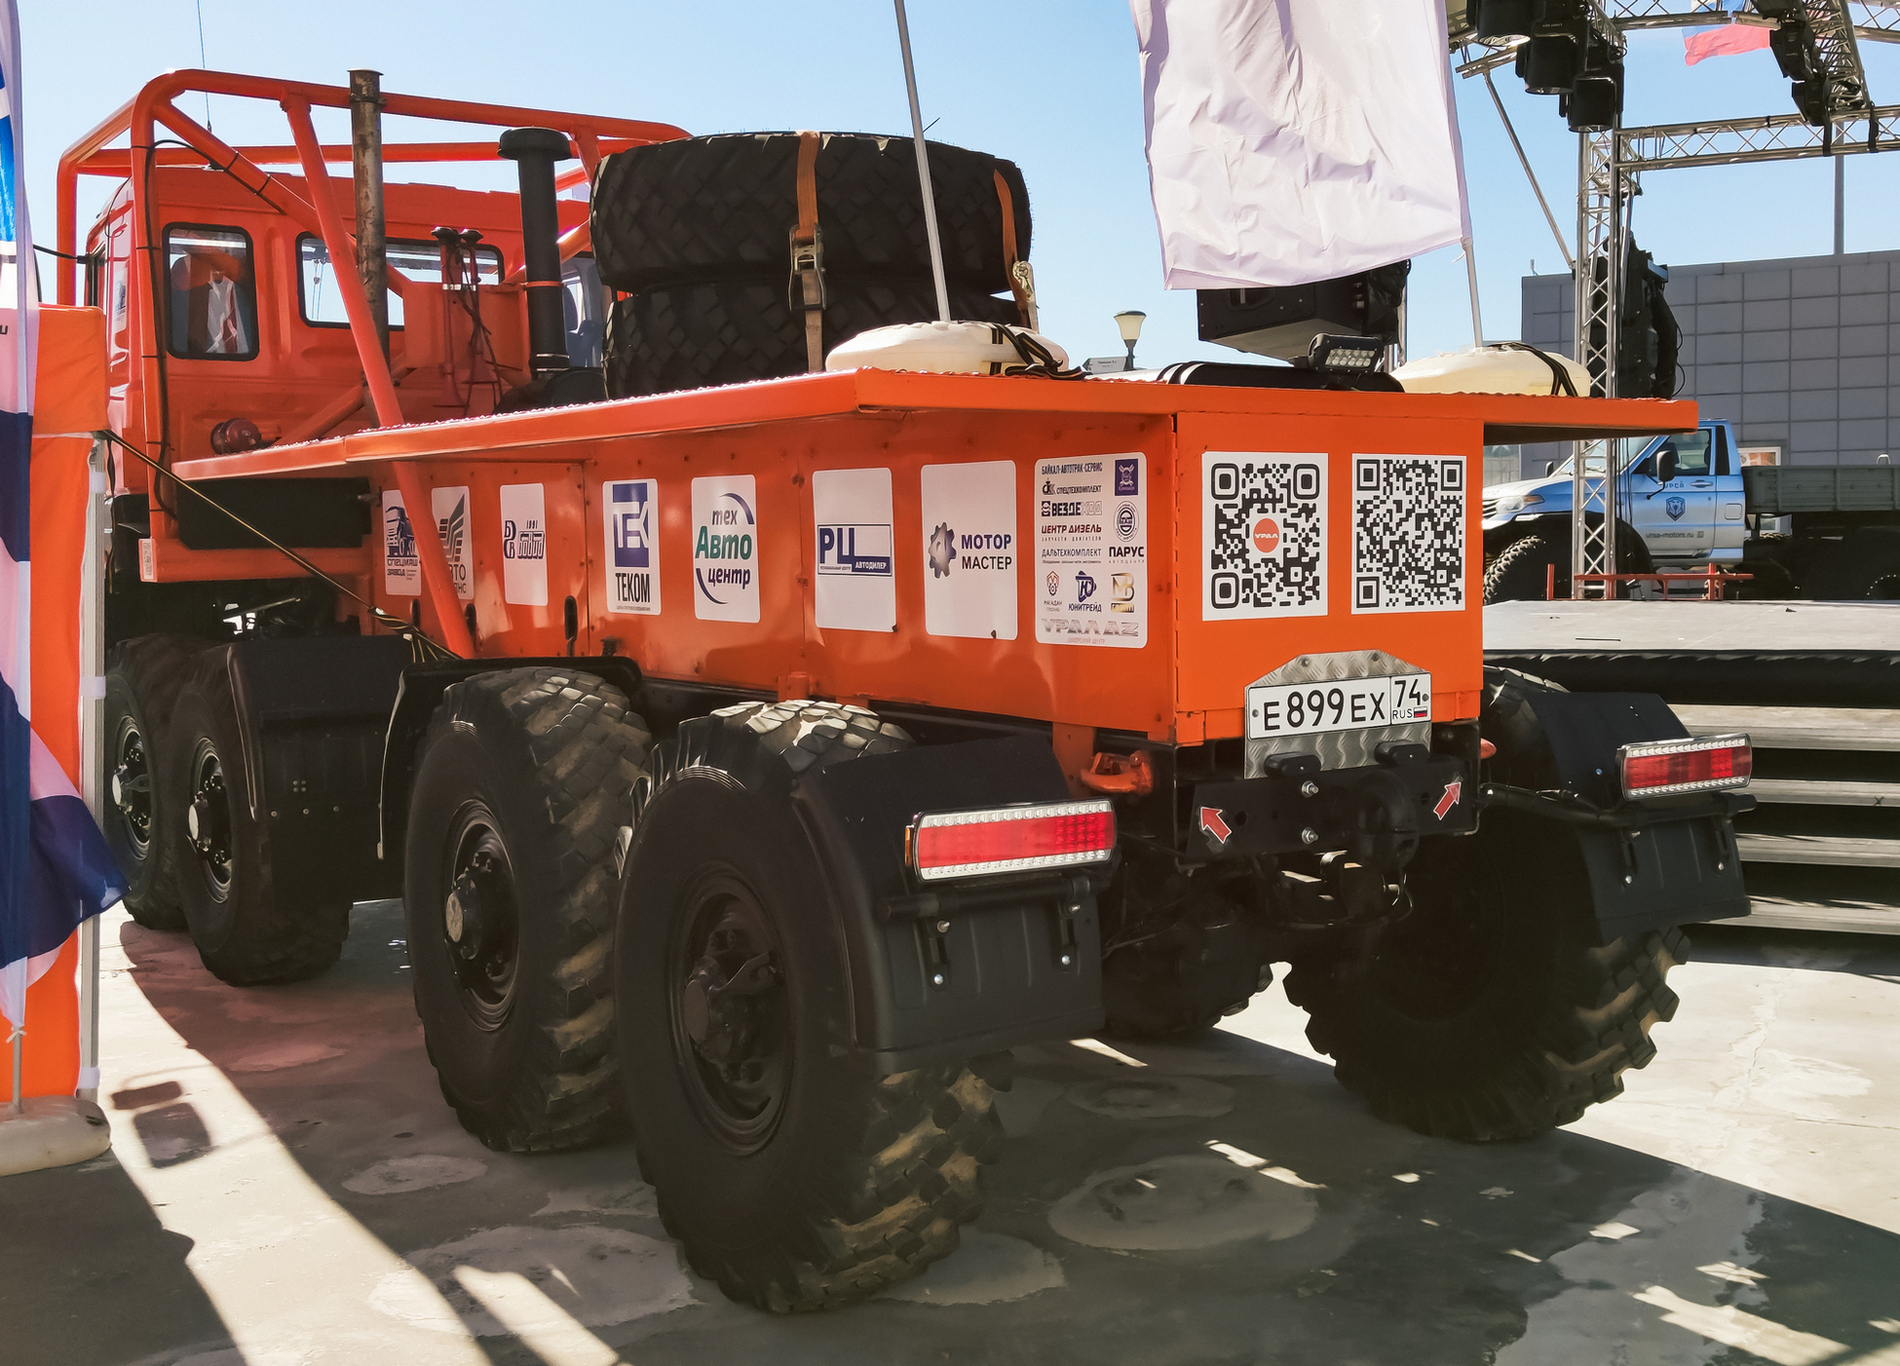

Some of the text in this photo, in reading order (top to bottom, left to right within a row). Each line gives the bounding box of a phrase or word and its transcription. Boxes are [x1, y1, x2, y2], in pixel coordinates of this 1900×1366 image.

[1041, 524, 1102, 534] ЦЕНТР ДИЗЕЛЬ
[694, 525, 752, 560] Авто
[819, 527, 855, 564] РЦ
[961, 534, 1012, 550] МОТОР
[1041, 548, 1102, 558] ДАЛЬТЕХКОМПЛЕКТ
[1108, 546, 1145, 557] ПАРУС
[855, 561, 887, 570] АВТОДИЛЕР
[962, 556, 1013, 570] МАСТЕР
[708, 568, 751, 590] центр
[615, 573, 651, 603] ТЕКОМ
[1068, 602, 1102, 613] ЮНИТРЕЙД
[1394, 679, 1421, 708] 74
[1392, 709, 1413, 719] RUS
